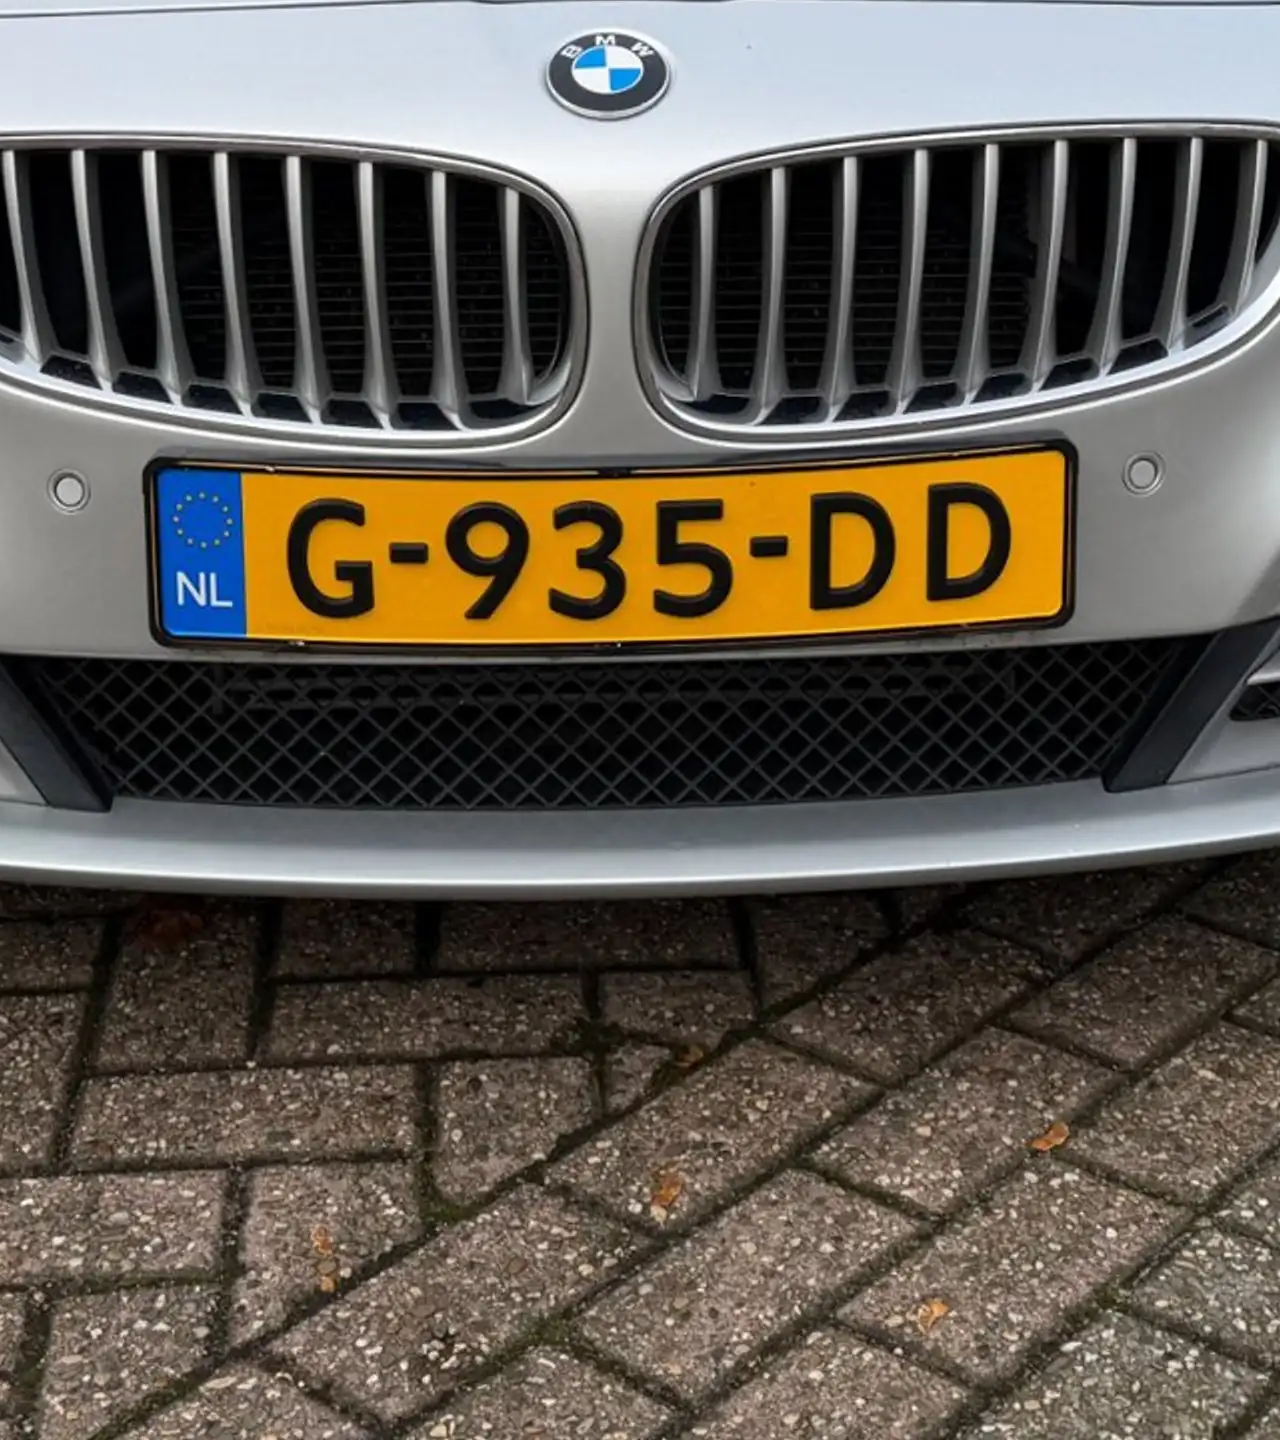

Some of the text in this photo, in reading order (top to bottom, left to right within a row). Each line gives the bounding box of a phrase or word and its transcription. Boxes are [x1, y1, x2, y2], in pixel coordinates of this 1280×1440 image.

[561, 34, 654, 59] BMW
[285, 481, 1012, 620] G-935-DD
[176, 570, 234, 607] NL
